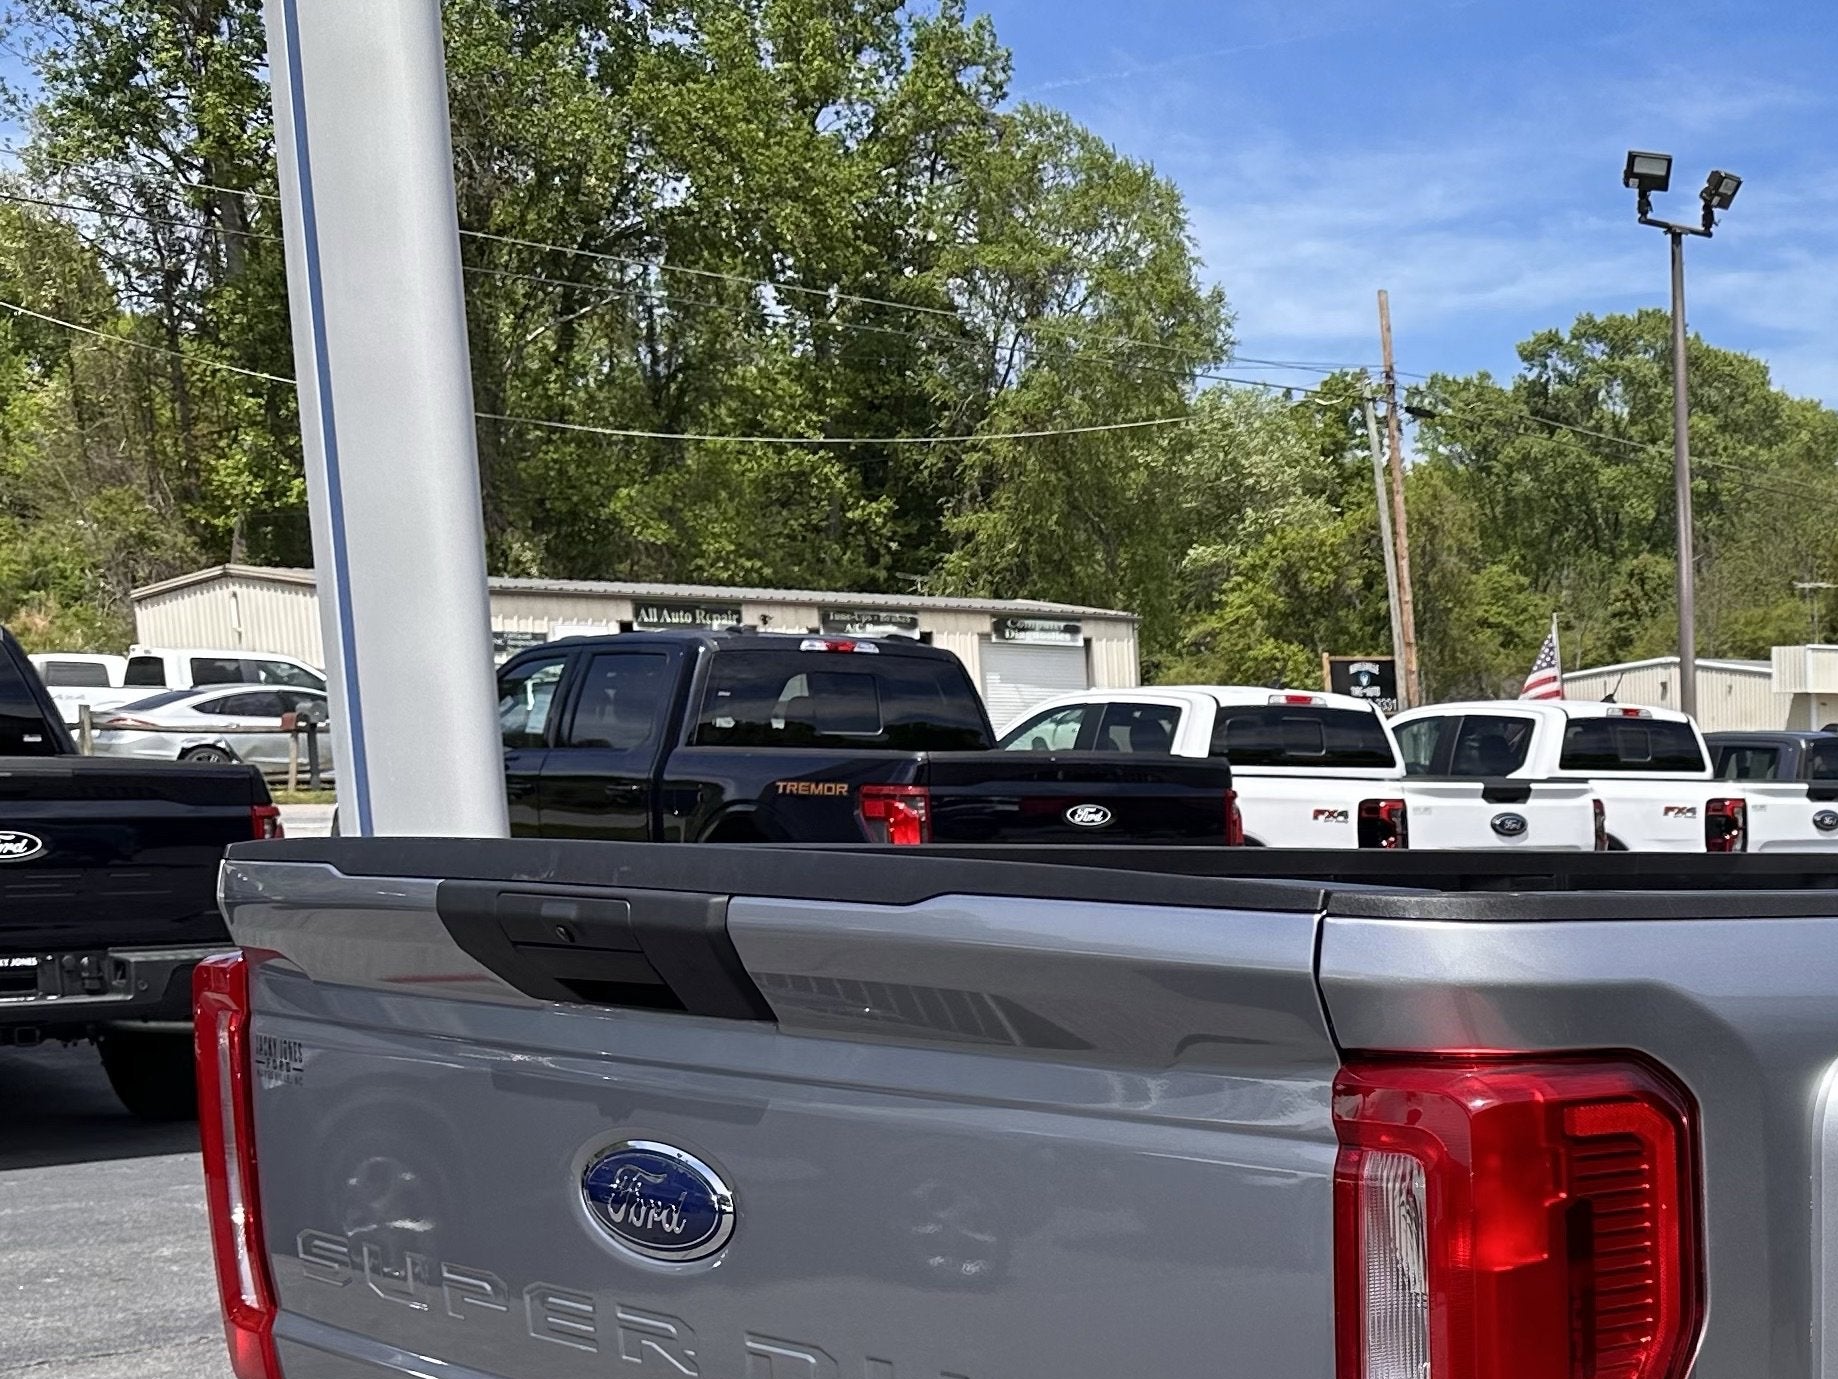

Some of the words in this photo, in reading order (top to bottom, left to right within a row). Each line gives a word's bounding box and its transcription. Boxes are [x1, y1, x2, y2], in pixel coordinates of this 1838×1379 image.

[638, 606, 658, 623] All
[660, 607, 692, 624] Auto
[695, 608, 739, 628] Repair
[775, 781, 849, 796] TREMOR
[1313, 809, 1348, 821] FX4
[10, 956, 38, 967] JONES
[607, 1163, 688, 1235] Ford
[297, 1228, 699, 1377] SUPER
